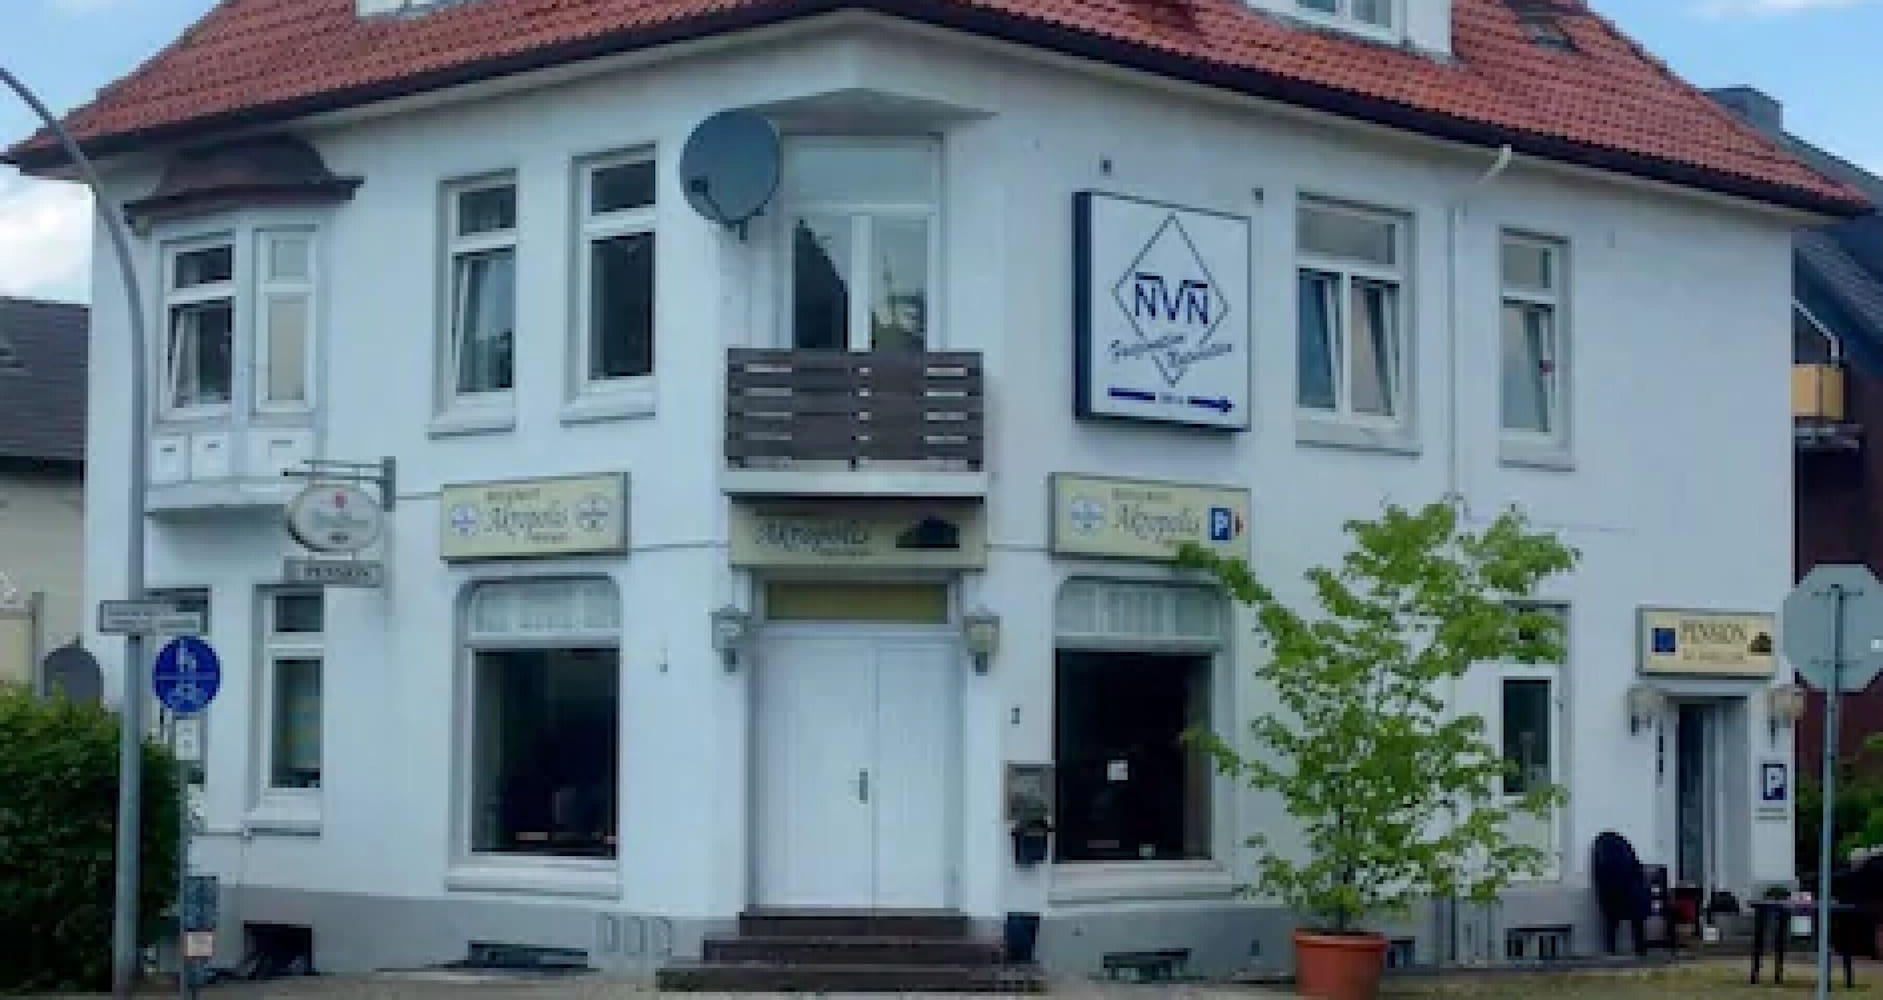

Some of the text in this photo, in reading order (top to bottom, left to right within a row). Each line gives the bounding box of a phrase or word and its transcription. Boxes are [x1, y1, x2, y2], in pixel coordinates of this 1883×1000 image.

[1135, 271, 1208, 324] NVN
[1680, 620, 1748, 646] PENSION
[1766, 767, 1783, 797] P
